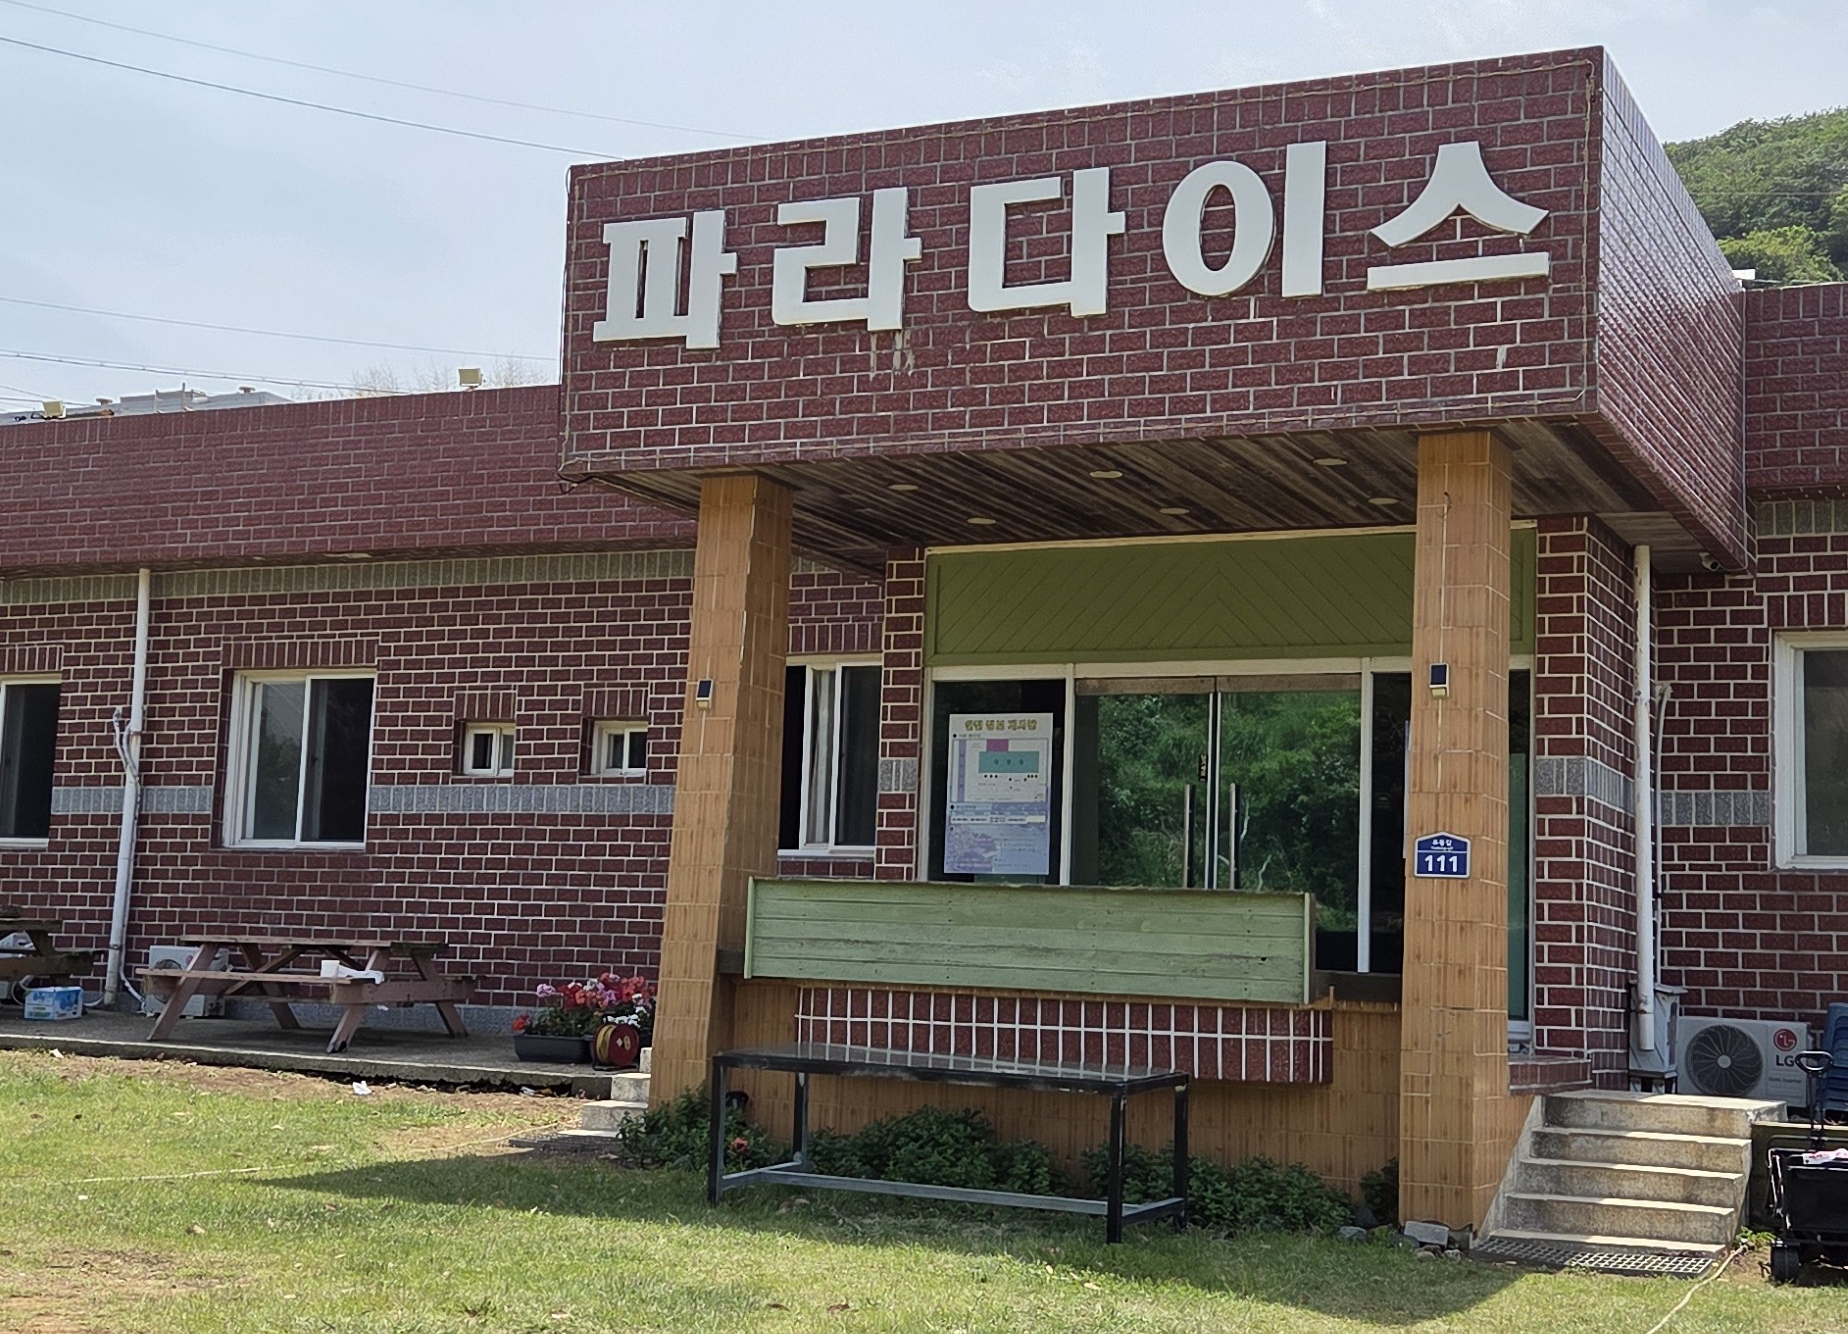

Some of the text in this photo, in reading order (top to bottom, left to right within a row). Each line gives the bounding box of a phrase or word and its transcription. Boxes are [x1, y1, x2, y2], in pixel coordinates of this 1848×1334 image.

[592, 140, 1550, 349] 파라다이스
[1425, 855, 1458, 872] 111
[1776, 1055, 1795, 1067] LG
